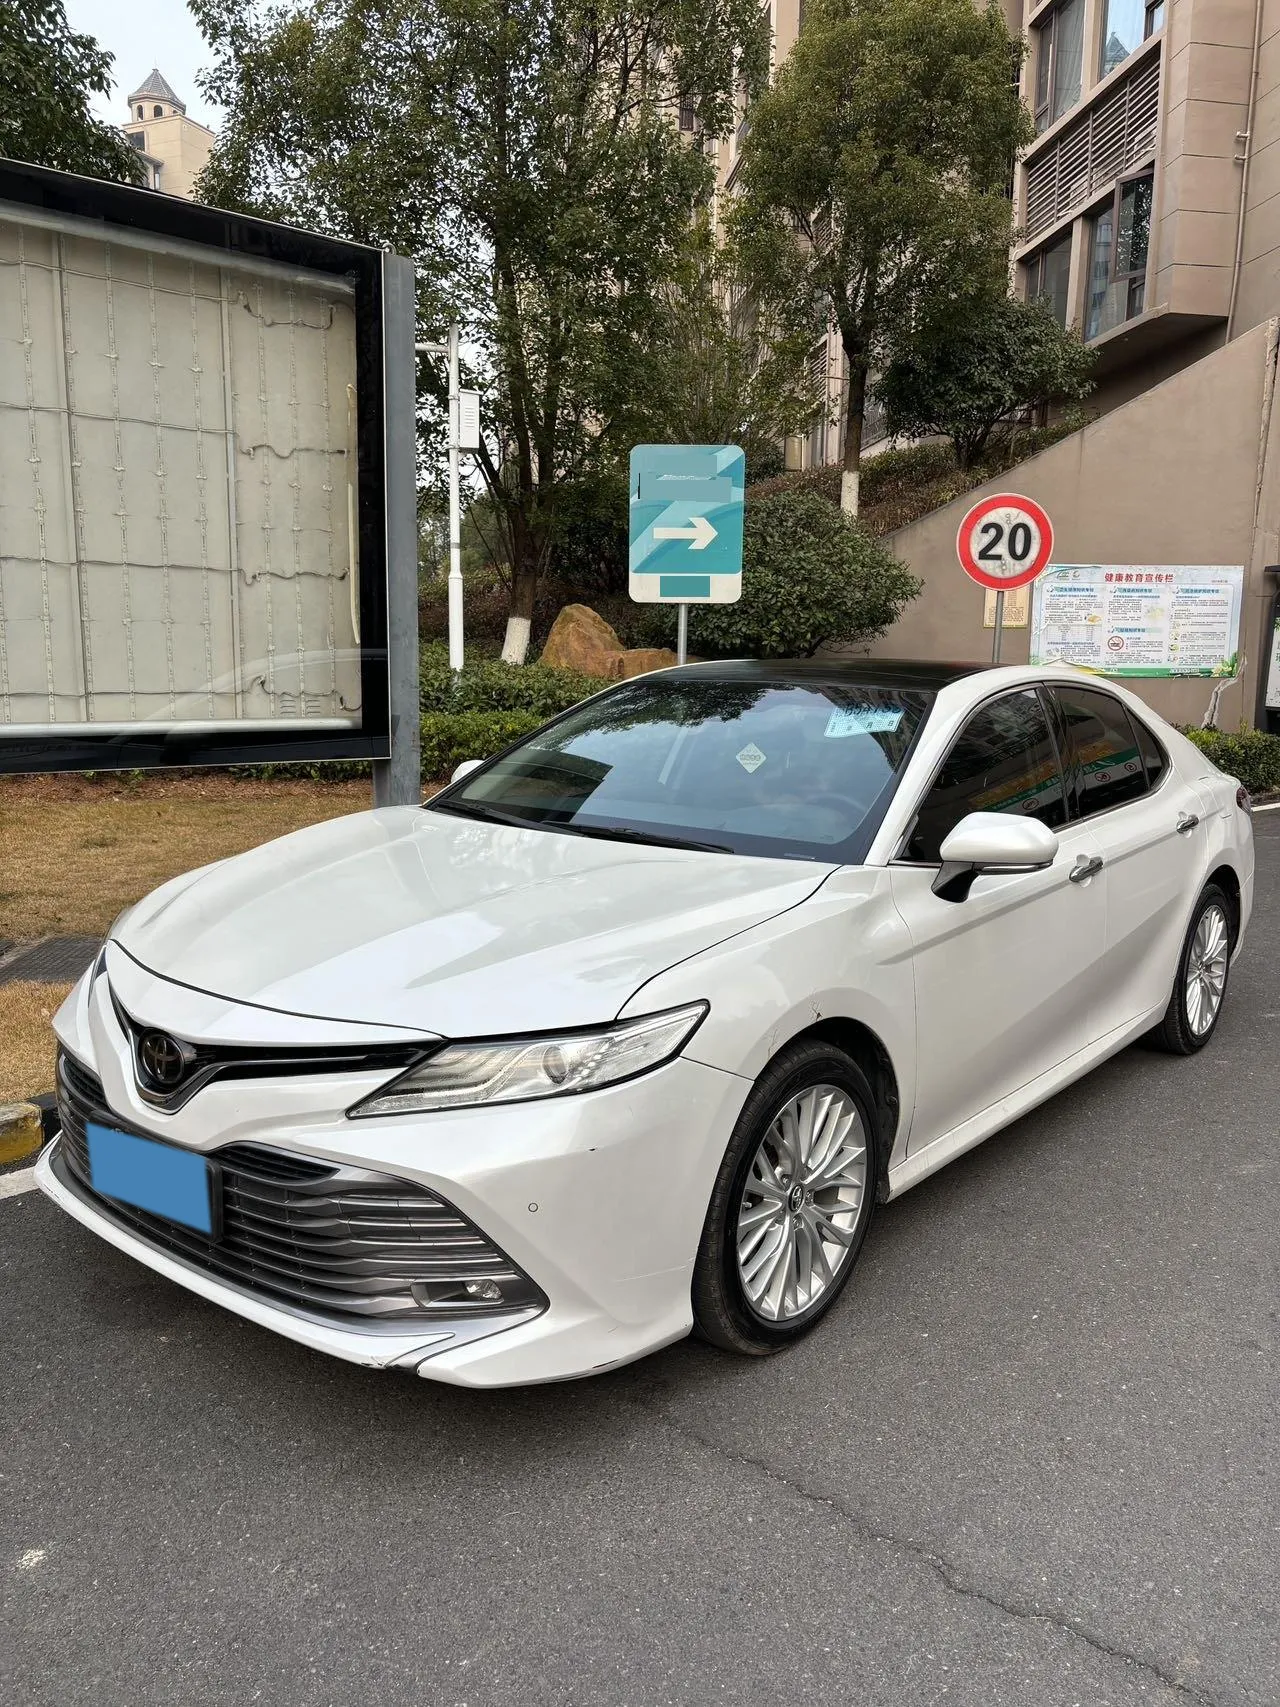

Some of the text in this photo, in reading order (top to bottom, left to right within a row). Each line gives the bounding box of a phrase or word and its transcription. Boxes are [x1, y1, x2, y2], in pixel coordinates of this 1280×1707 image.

[979, 523, 1031, 560] 20
[1104, 573, 1174, 583] 健康教育宣传栏
